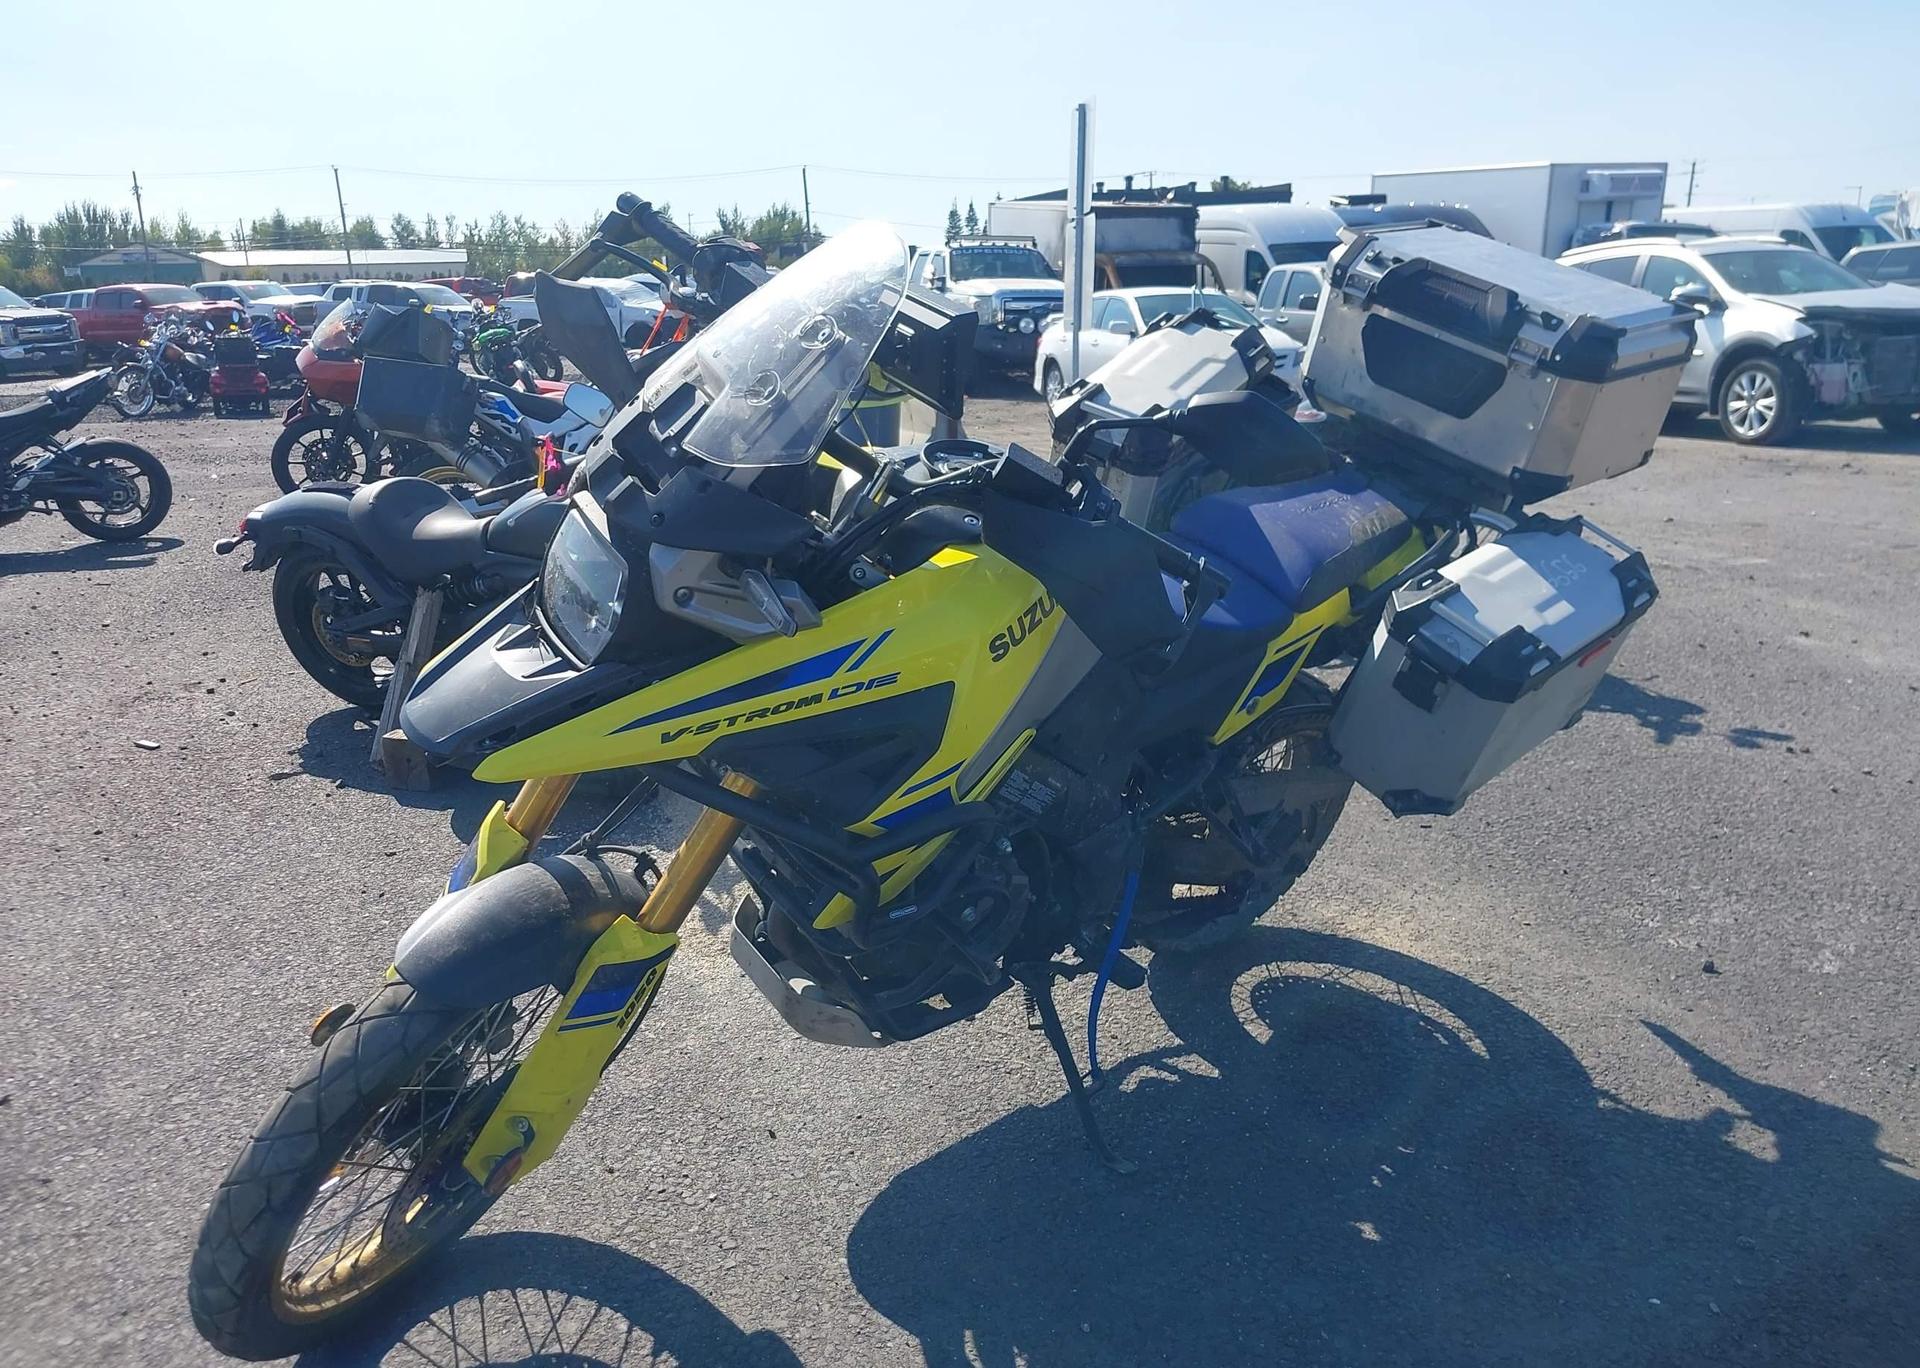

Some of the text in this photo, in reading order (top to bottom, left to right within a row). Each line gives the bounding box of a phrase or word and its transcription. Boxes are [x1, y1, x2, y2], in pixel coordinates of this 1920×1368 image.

[988, 591, 1056, 663] SUZU
[660, 693, 823, 744] V-STROM
[616, 967, 658, 1029] 1050
